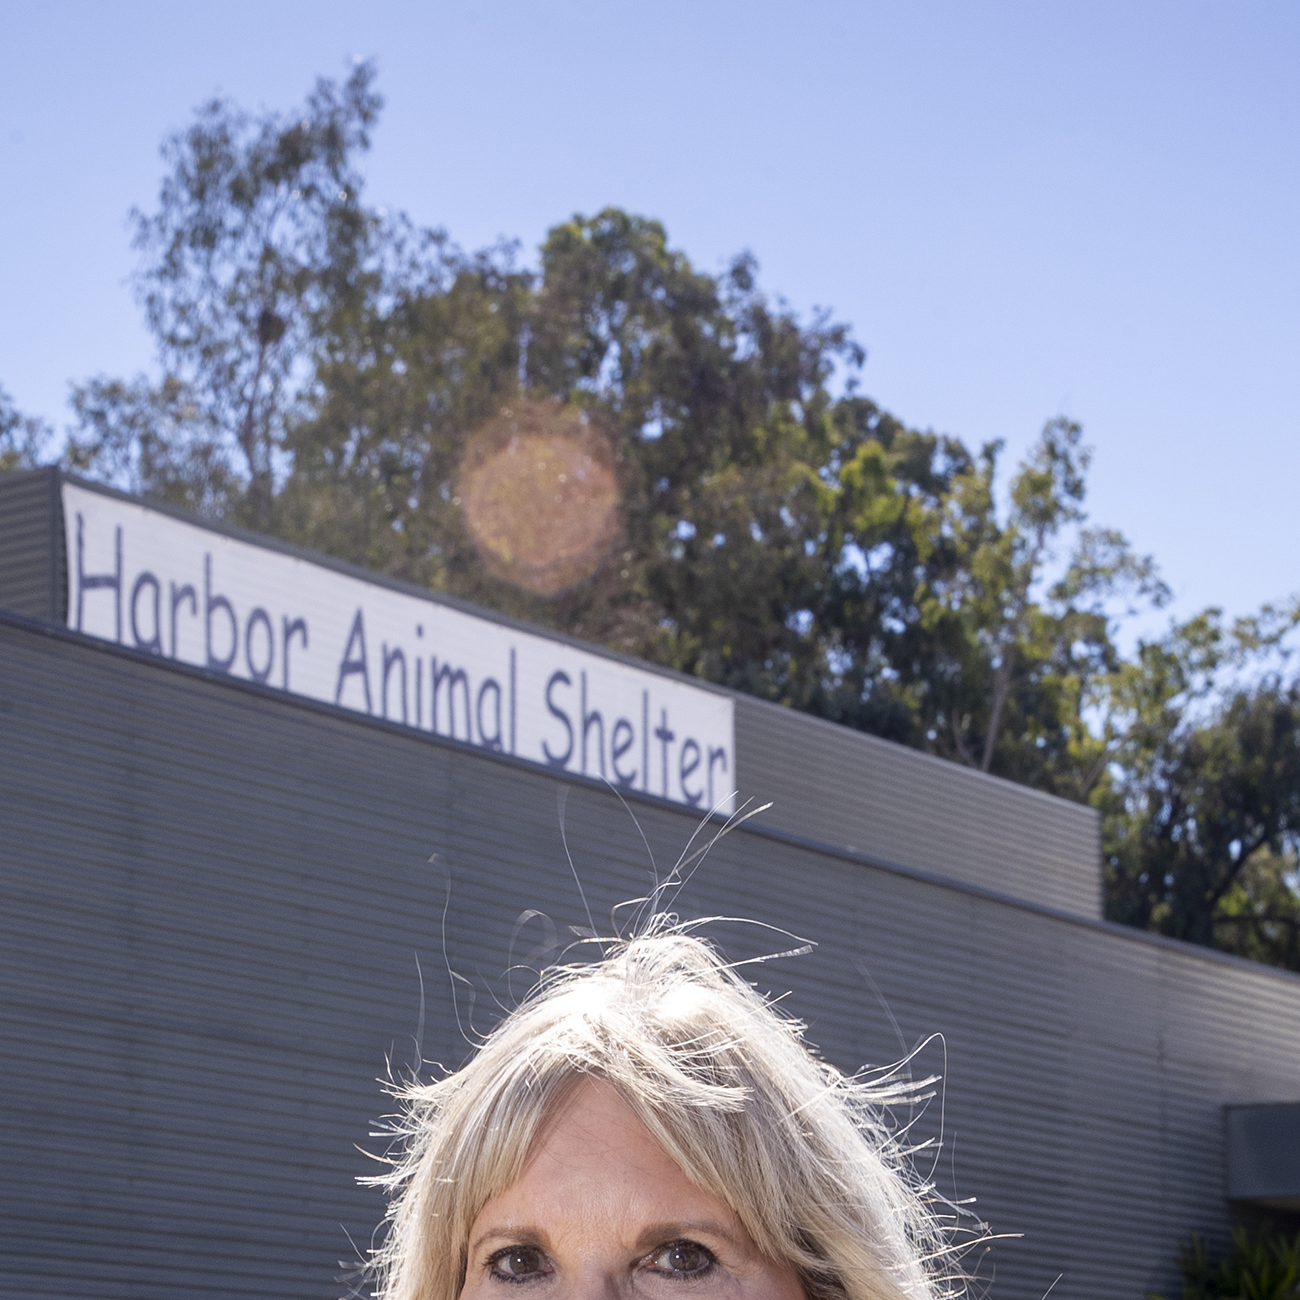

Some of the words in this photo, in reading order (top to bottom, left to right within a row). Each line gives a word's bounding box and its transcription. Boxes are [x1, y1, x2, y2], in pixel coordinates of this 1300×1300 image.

[75, 511, 308, 693] Harbor
[336, 608, 517, 756] Animal
[541, 668, 728, 806] Shelter
